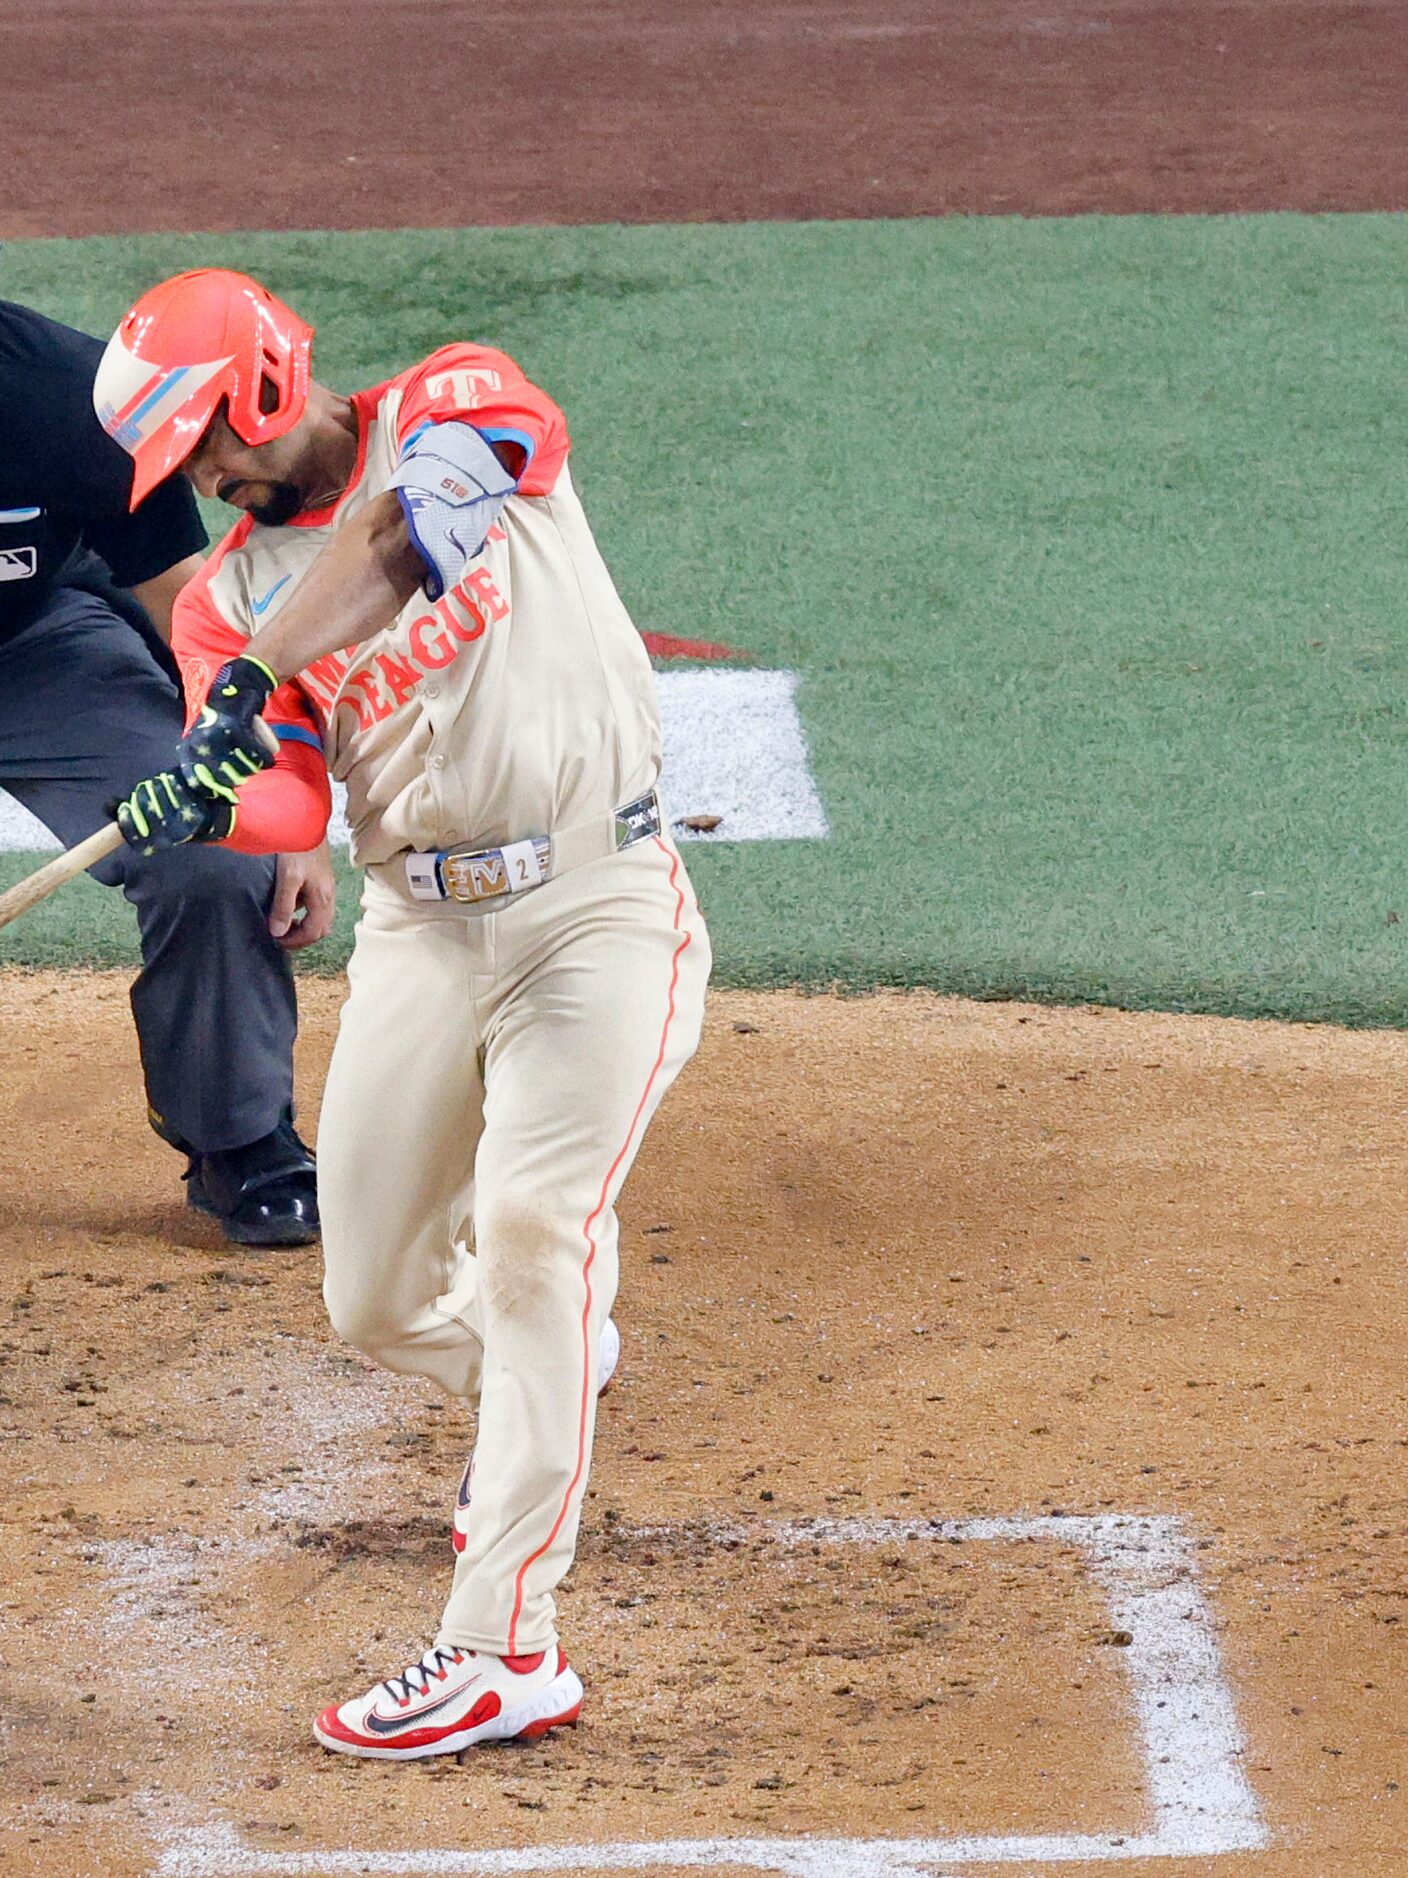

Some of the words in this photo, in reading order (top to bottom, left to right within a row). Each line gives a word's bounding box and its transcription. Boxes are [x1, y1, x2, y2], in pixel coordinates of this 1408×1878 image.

[425, 369, 502, 409] T
[336, 566, 511, 733] LEAGUE
[516, 858, 529, 881] 2
